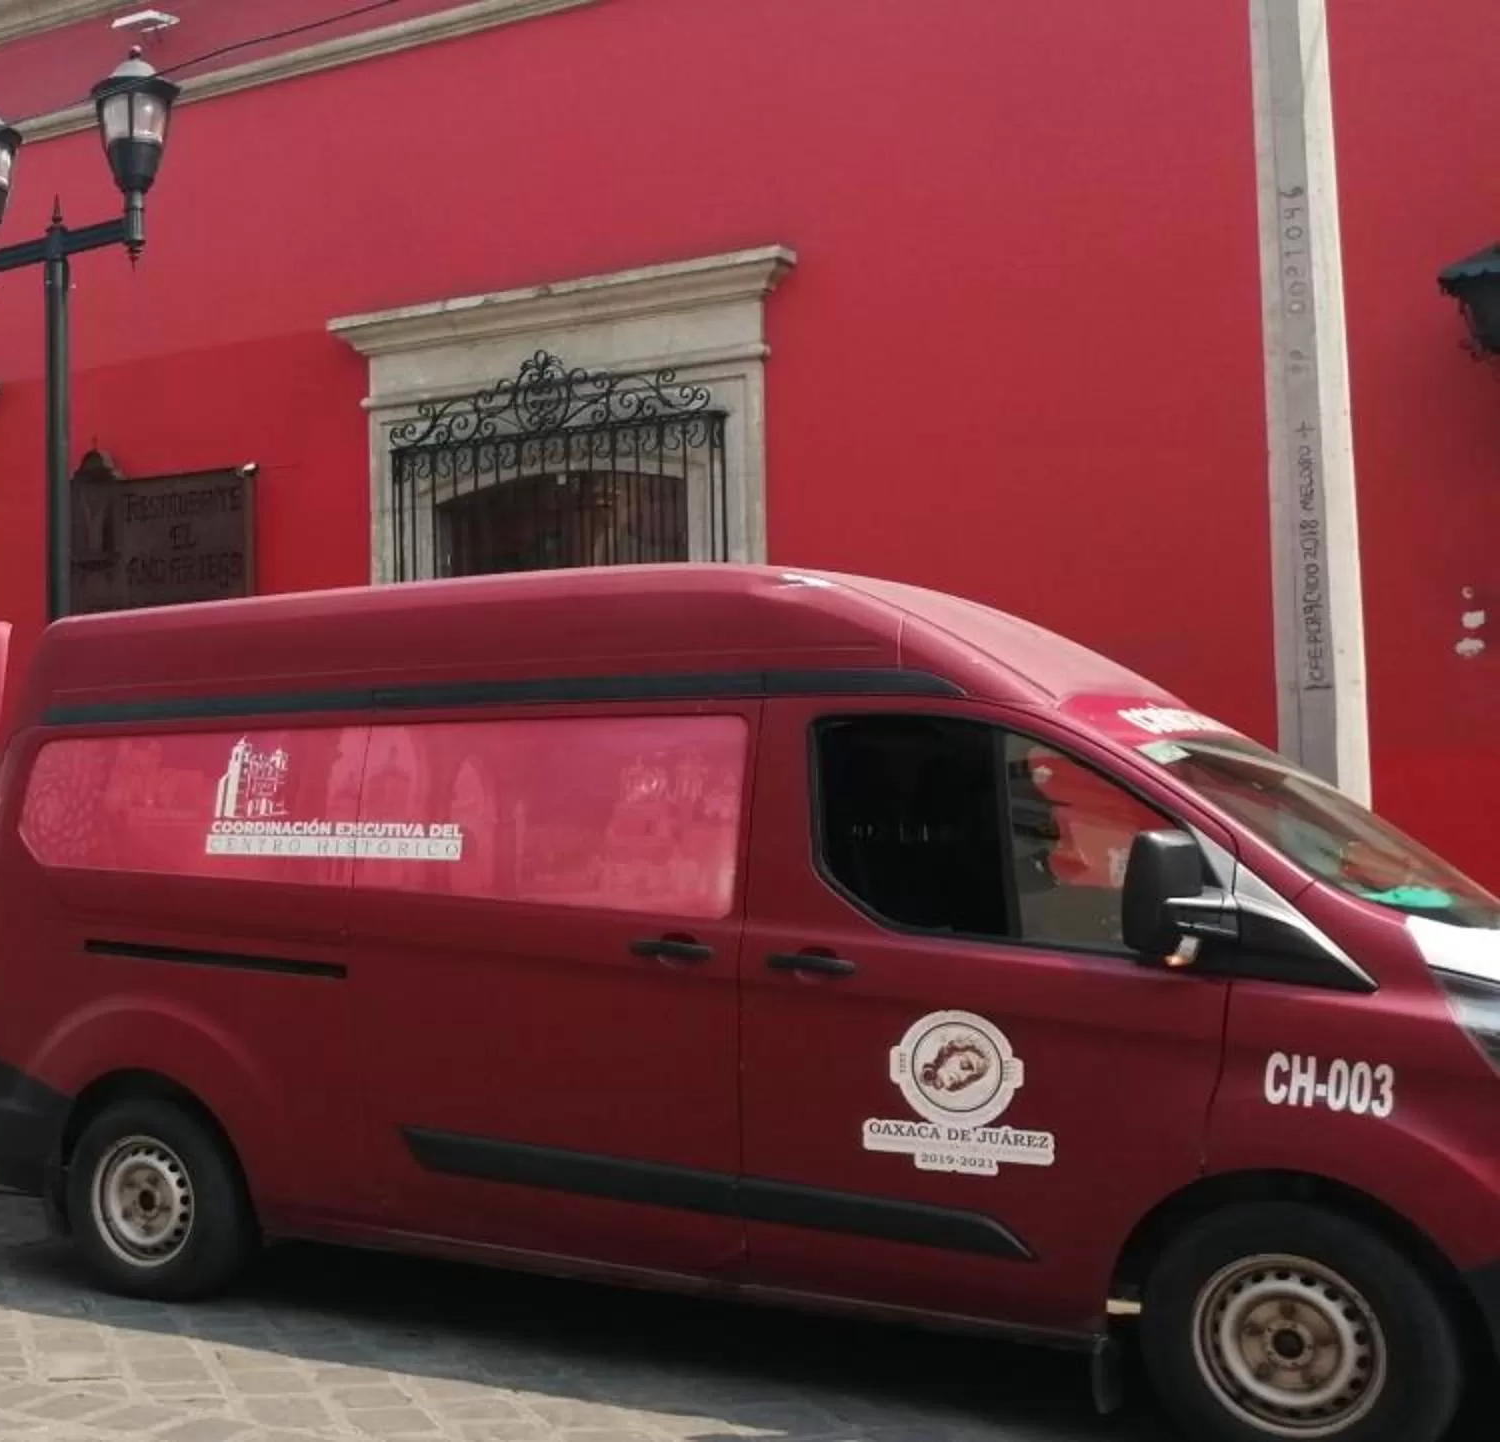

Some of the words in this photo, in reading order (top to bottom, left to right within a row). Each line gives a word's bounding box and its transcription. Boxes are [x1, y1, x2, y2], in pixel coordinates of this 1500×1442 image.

[211, 818, 332, 836] COORDINACIÓN
[335, 822, 425, 837] EJECUTIVA
[429, 823, 463, 838] DEL
[210, 837, 301, 853] CENTRO
[1264, 1051, 1395, 1118] CH-003
[869, 1121, 940, 1140] OAXACA
[947, 1128, 971, 1142] DE
[976, 1126, 1050, 1149] JUÁREZ
[921, 1152, 994, 1169] 2019-2021
